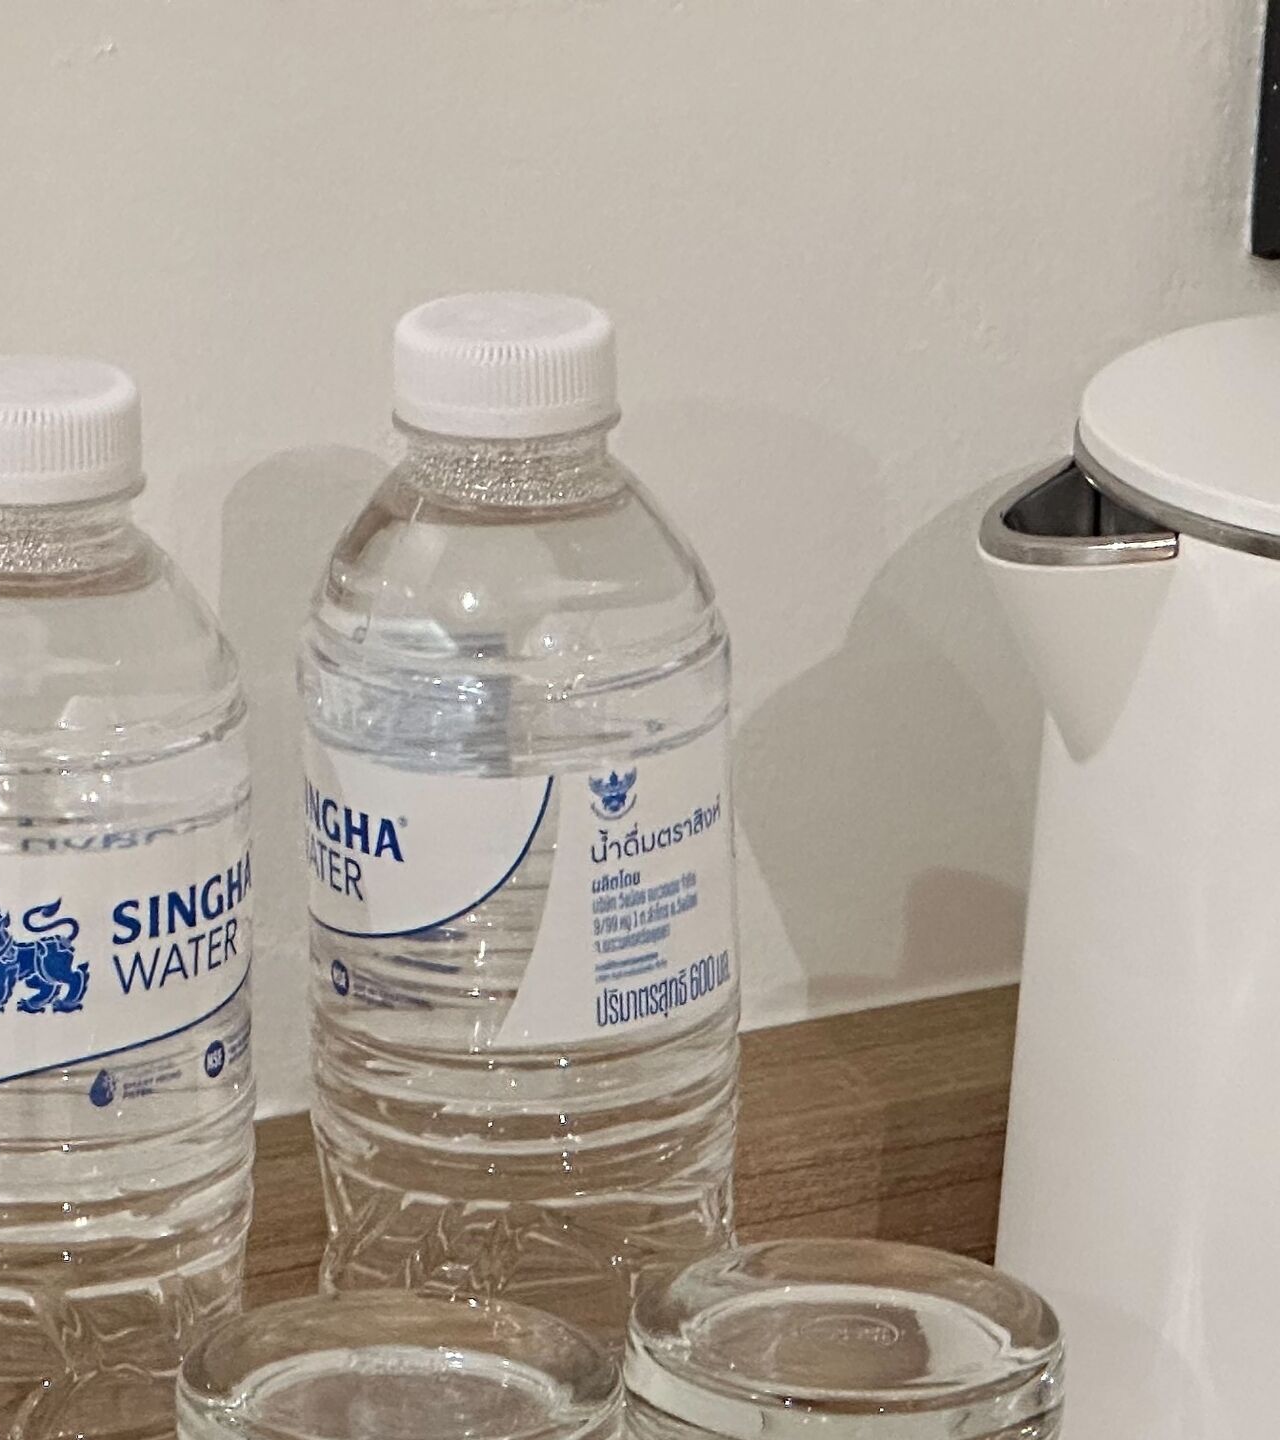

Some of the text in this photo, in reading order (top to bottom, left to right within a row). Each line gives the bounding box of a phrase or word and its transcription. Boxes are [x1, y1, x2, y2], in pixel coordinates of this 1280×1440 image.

[304, 776, 405, 863] INGHA
[112, 848, 252, 946] SINGHA
[306, 832, 364, 902] ATER
[113, 918, 238, 996] WATER
[596, 968, 688, 1028] ปริมาตรสุทธิ
[689, 955, 716, 1002] 600
